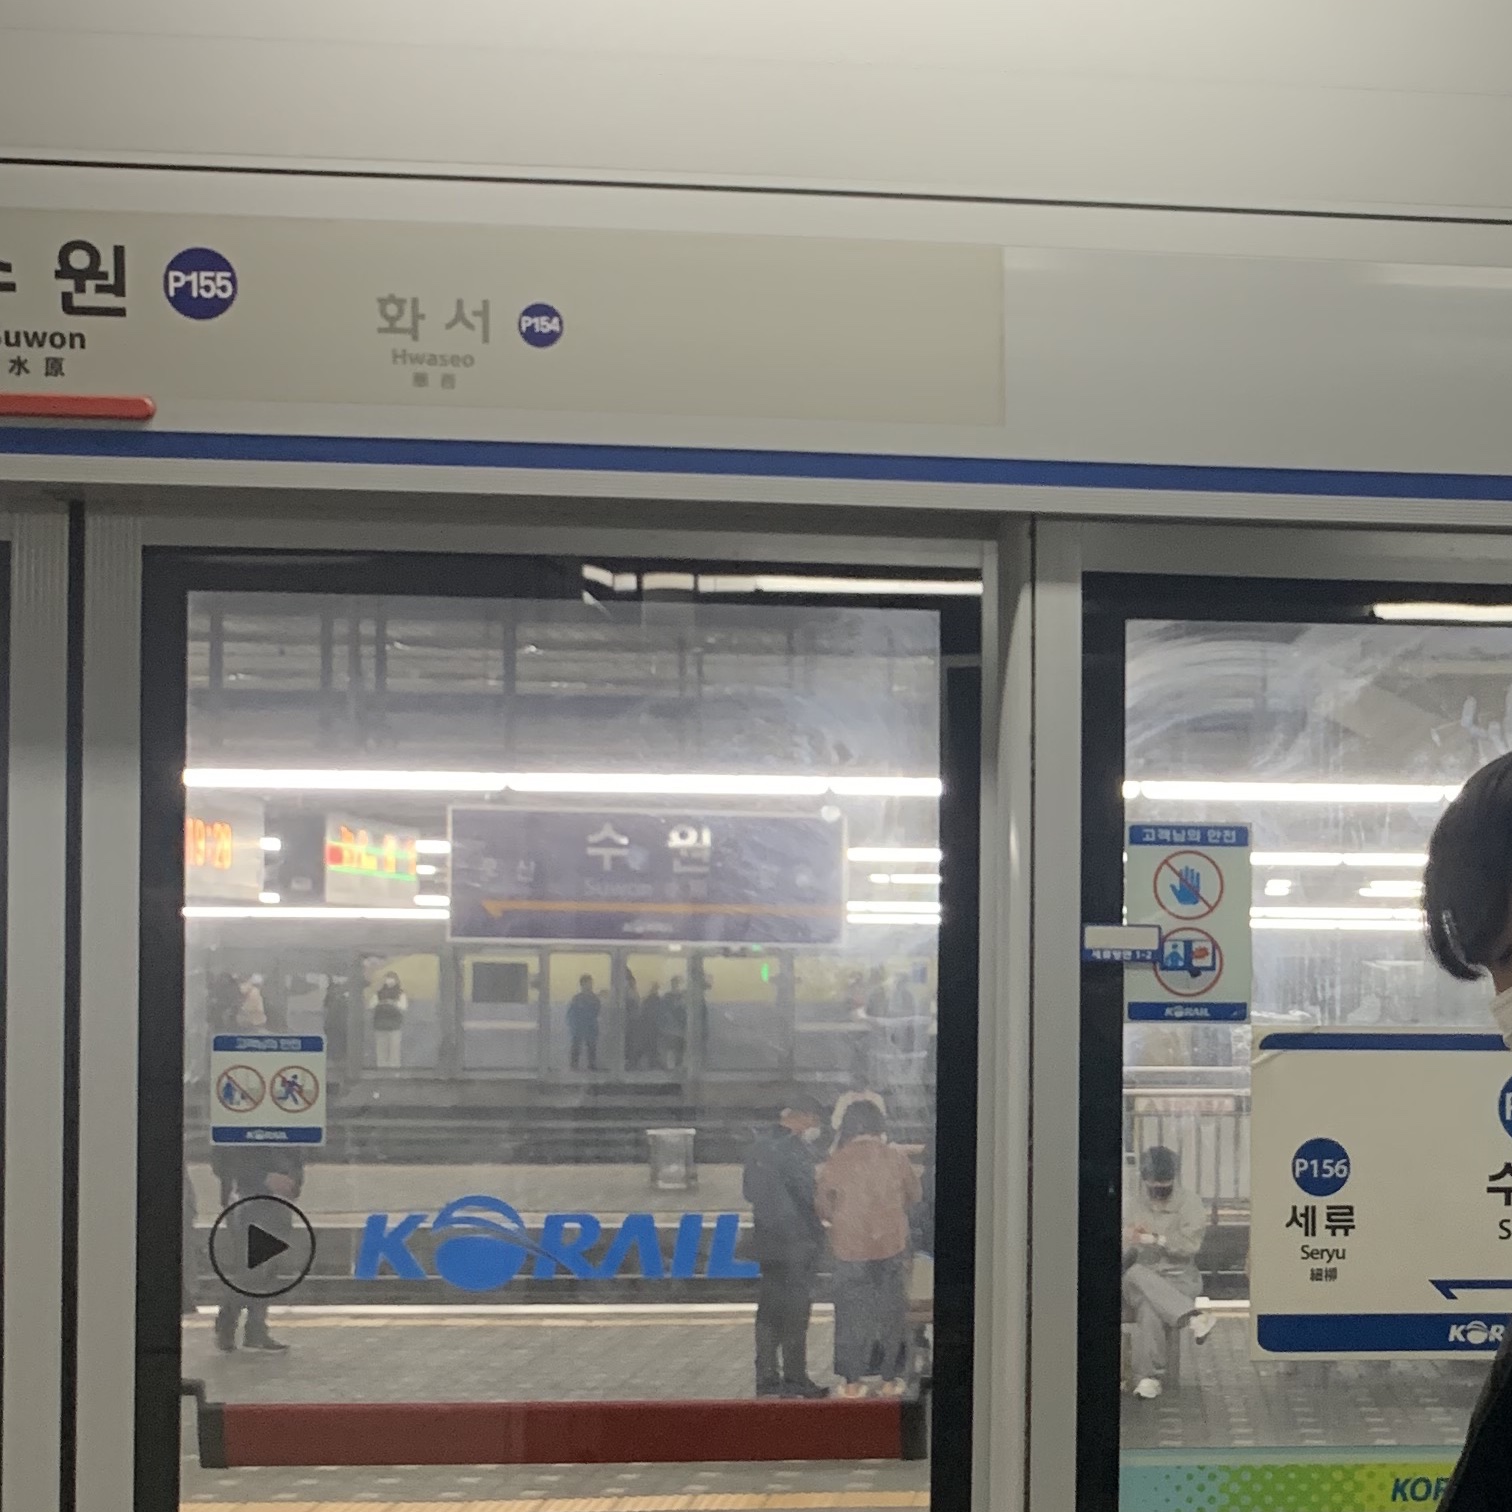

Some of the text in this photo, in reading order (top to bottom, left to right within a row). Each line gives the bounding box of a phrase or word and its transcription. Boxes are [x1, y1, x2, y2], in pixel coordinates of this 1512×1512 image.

[167, 269, 234, 299] P155
[519, 314, 561, 334] P154
[0, 329, 87, 350] uwon
[391, 348, 476, 369] Hwaseo
[1206, 828, 1237, 844] 안전
[1293, 1157, 1349, 1179] P156
[1284, 1204, 1357, 1238] 세류
[354, 1194, 762, 1292] KORAIL
[1299, 1244, 1347, 1264] Seryu
